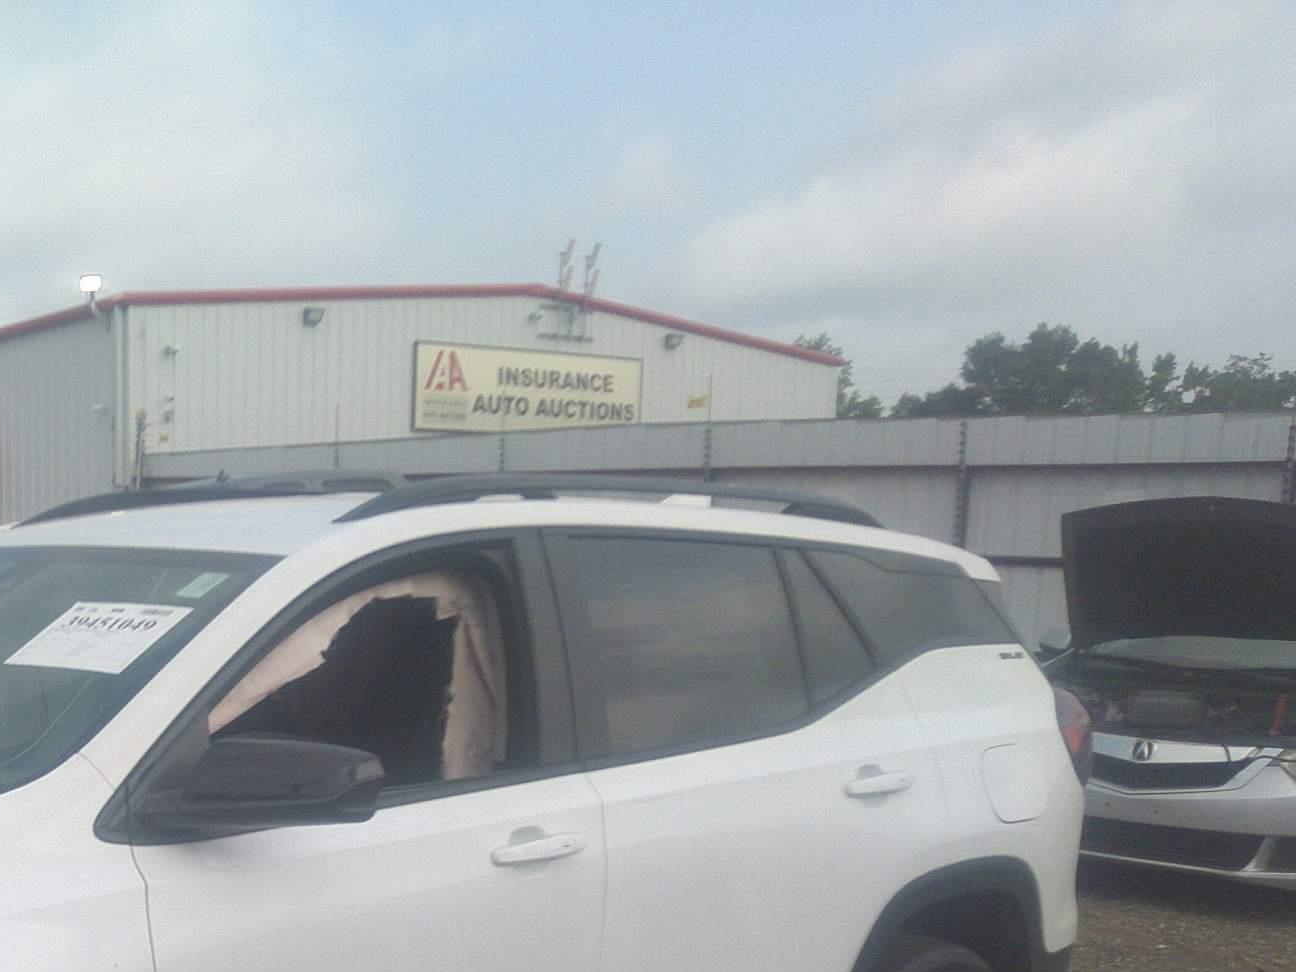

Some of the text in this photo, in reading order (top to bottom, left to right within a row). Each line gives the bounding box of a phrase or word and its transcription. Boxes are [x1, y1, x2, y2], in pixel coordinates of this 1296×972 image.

[498, 366, 614, 393] INSURANCE
[472, 393, 529, 416] AUTO
[535, 398, 634, 421] AUCTIONS
